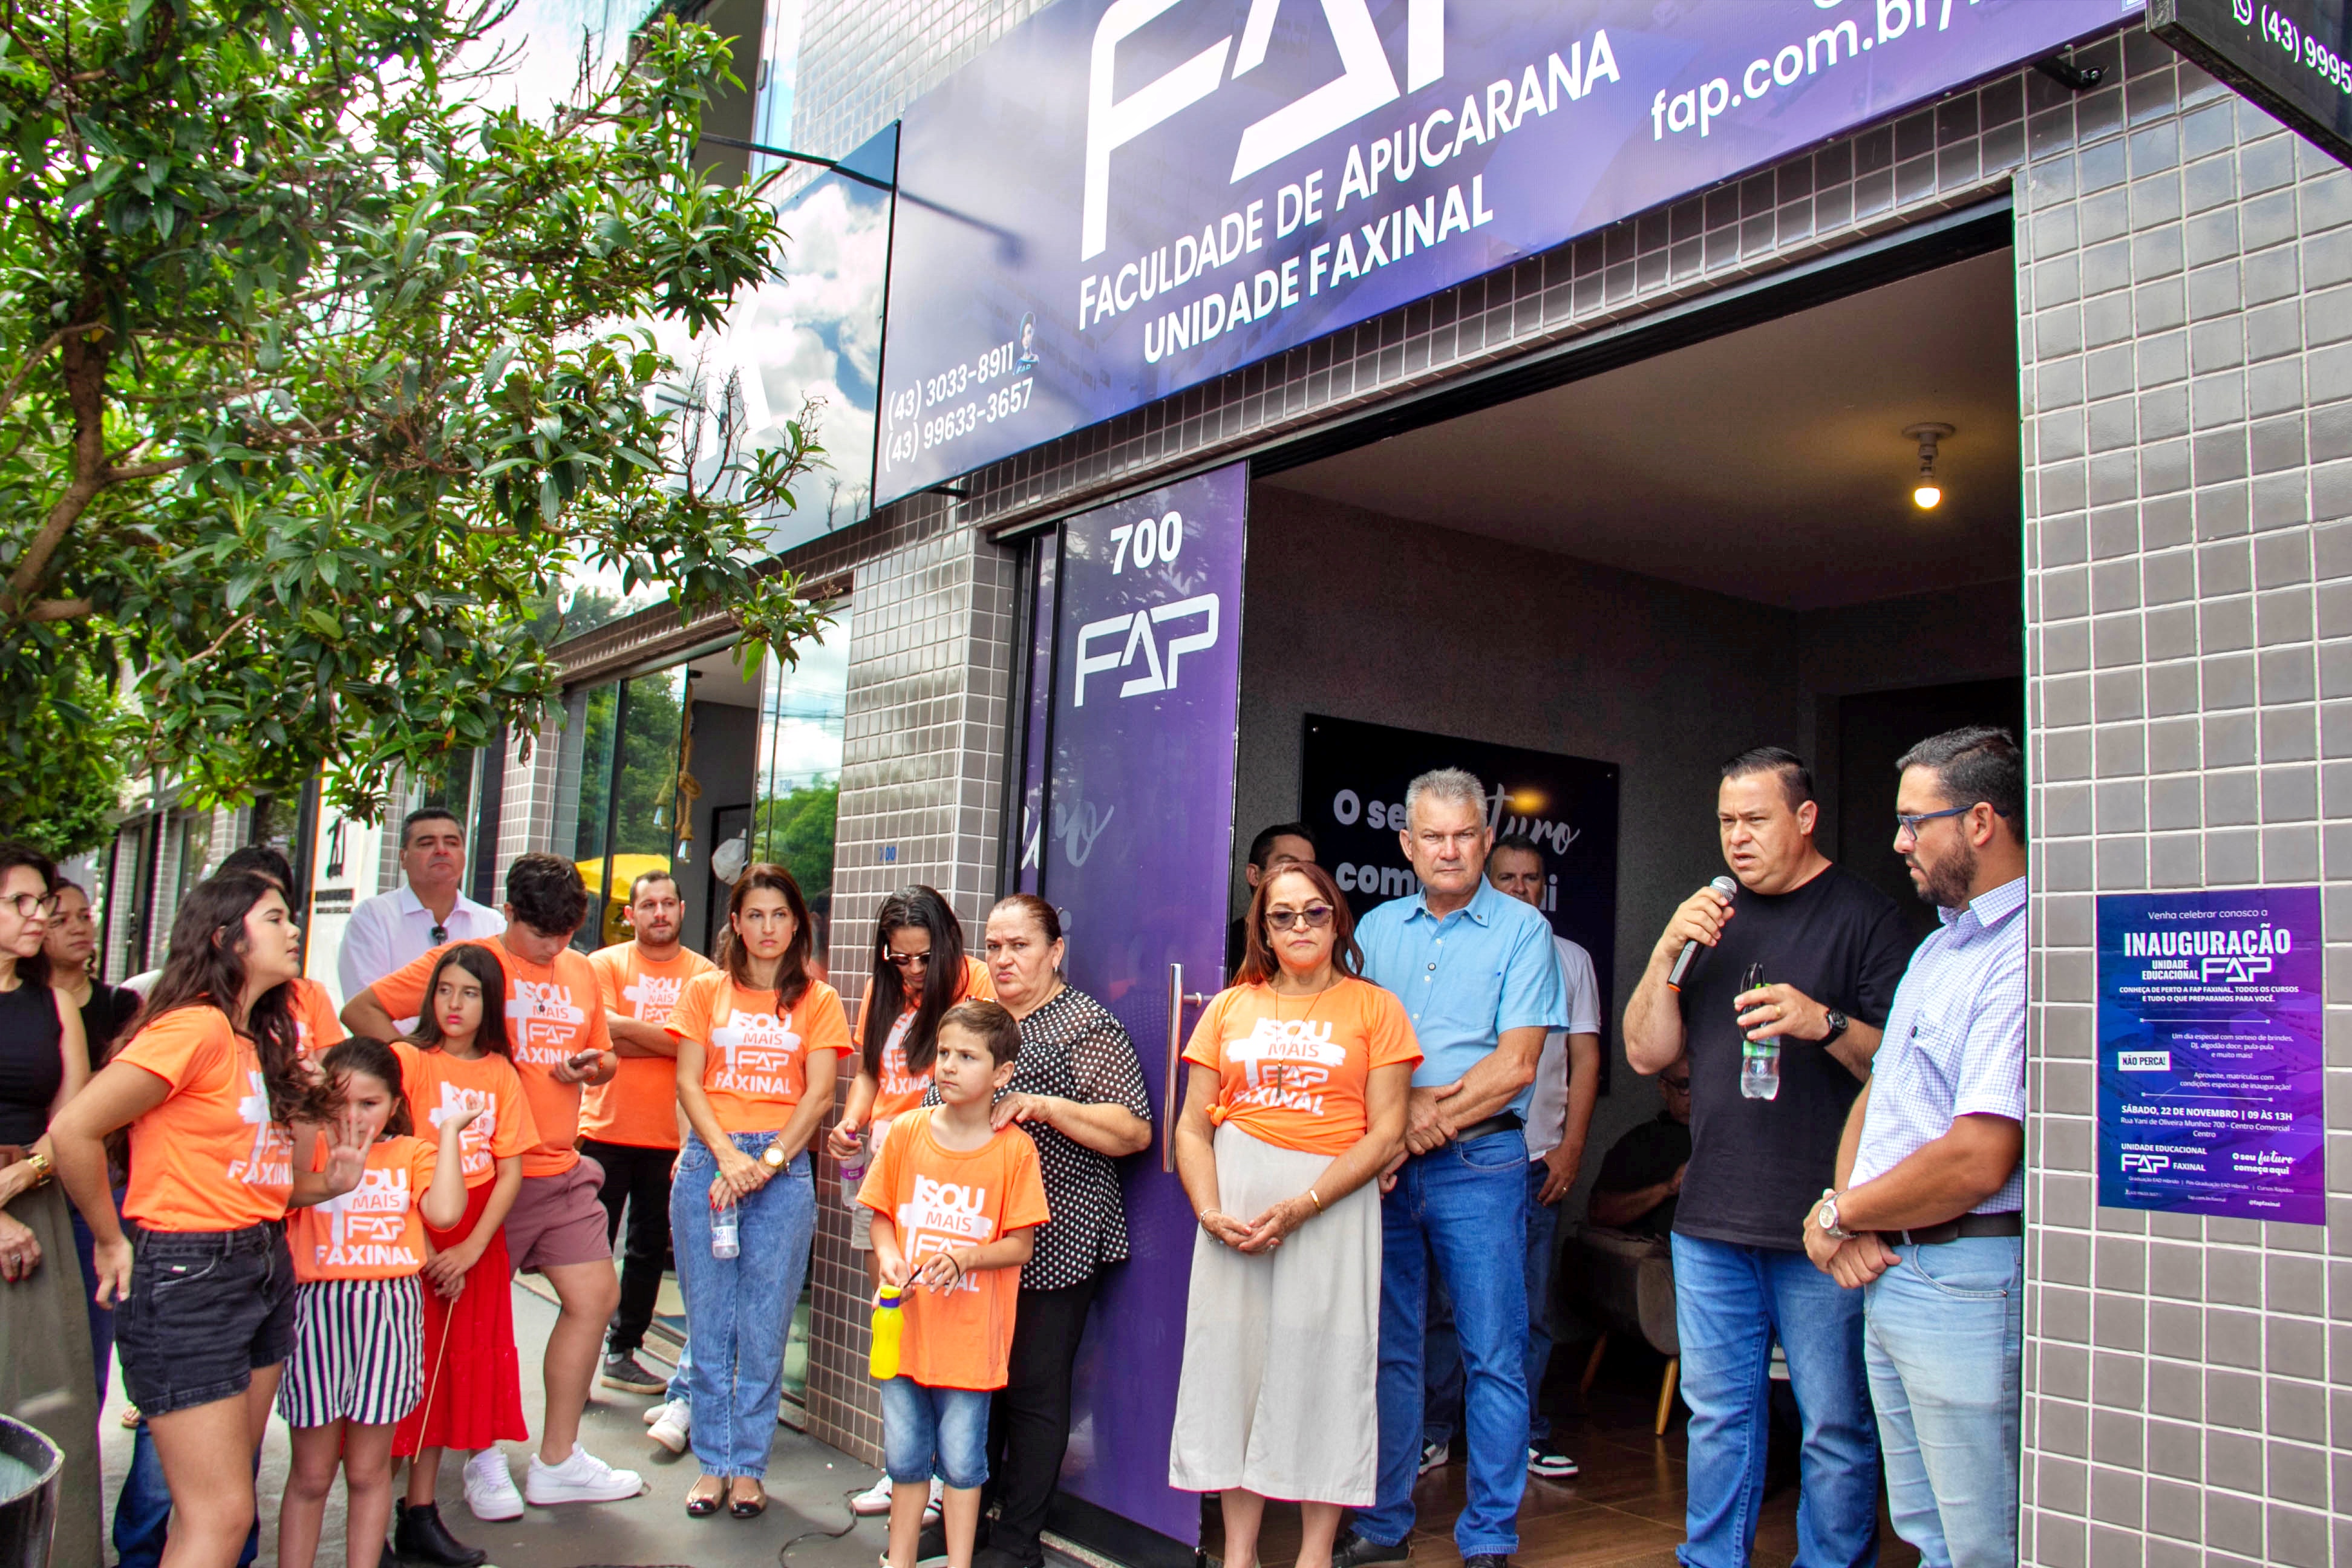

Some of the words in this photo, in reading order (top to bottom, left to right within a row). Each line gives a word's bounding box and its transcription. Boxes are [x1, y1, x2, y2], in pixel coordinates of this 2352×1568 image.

[2261, 4, 2299, 63] (43)
[1651, 0, 1980, 141] fap.com.br/
[1079, 200, 1263, 330] FACULDADE
[1276, 169, 1323, 239] DE
[1336, 28, 1621, 211] APUCARANA
[1144, 255, 1299, 364] UNIDADE
[1309, 174, 1493, 297] FAXINAL
[888, 380, 921, 431] (43)
[926, 341, 1014, 407] 3033-8911
[885, 422, 918, 472] (43)
[924, 377, 1033, 449] 99633-3657
[1110, 511, 1183, 575] 700
[1074, 593, 1220, 707] FAP
[1333, 789, 1361, 825] O
[1367, 799, 1406, 832] se
[1486, 783, 1581, 855] turo
[1335, 862, 1420, 897] com
[2148, 911, 2177, 920] Venha
[2179, 910, 2217, 919] celebrar
[2124, 923, 2291, 958] INAUGURAÇÃO
[2142, 970, 2200, 980] EDUCACIONAL
[2152, 960, 2189, 969] UNIDADE
[2202, 957, 2272, 982] FAP
[528, 1022, 577, 1045] FAP
[737, 1012, 792, 1032] SOU
[1262, 1019, 1333, 1042] SOU
[743, 1032, 783, 1046] MAIS
[1268, 1043, 1319, 1058] MAIS
[737, 1050, 790, 1073] FAP
[2123, 1055, 2137, 1065] NÃO
[2139, 1057, 2166, 1066] PERCA!
[714, 1071, 792, 1095] FAXINAL
[1262, 1065, 1329, 1088] FAP
[2122, 1104, 2159, 1116] SÁBADO,
[2186, 1108, 2238, 1118] NOVEMBRO
[2247, 1111, 2258, 1119] 09
[2261, 1110, 2273, 1120] ÀS
[2275, 1112, 2292, 1121] 13H
[2255, 1123, 2290, 1132] Comercial
[2121, 1143, 2154, 1152] UNIDADE
[2155, 1144, 2207, 1154] EDUCACIONAL
[227, 1159, 295, 1185] FAXIN
[2121, 1154, 2169, 1174] FAP
[2173, 1163, 2206, 1172] FAXINAL
[2269, 1167, 2289, 1176] aqui
[359, 1168, 407, 1192] OU
[353, 1194, 401, 1209] MAIS
[922, 1178, 985, 1215] SOU
[347, 1215, 406, 1241] FAP
[926, 1210, 973, 1232] MAIS
[315, 1244, 420, 1266] FAXINAL
